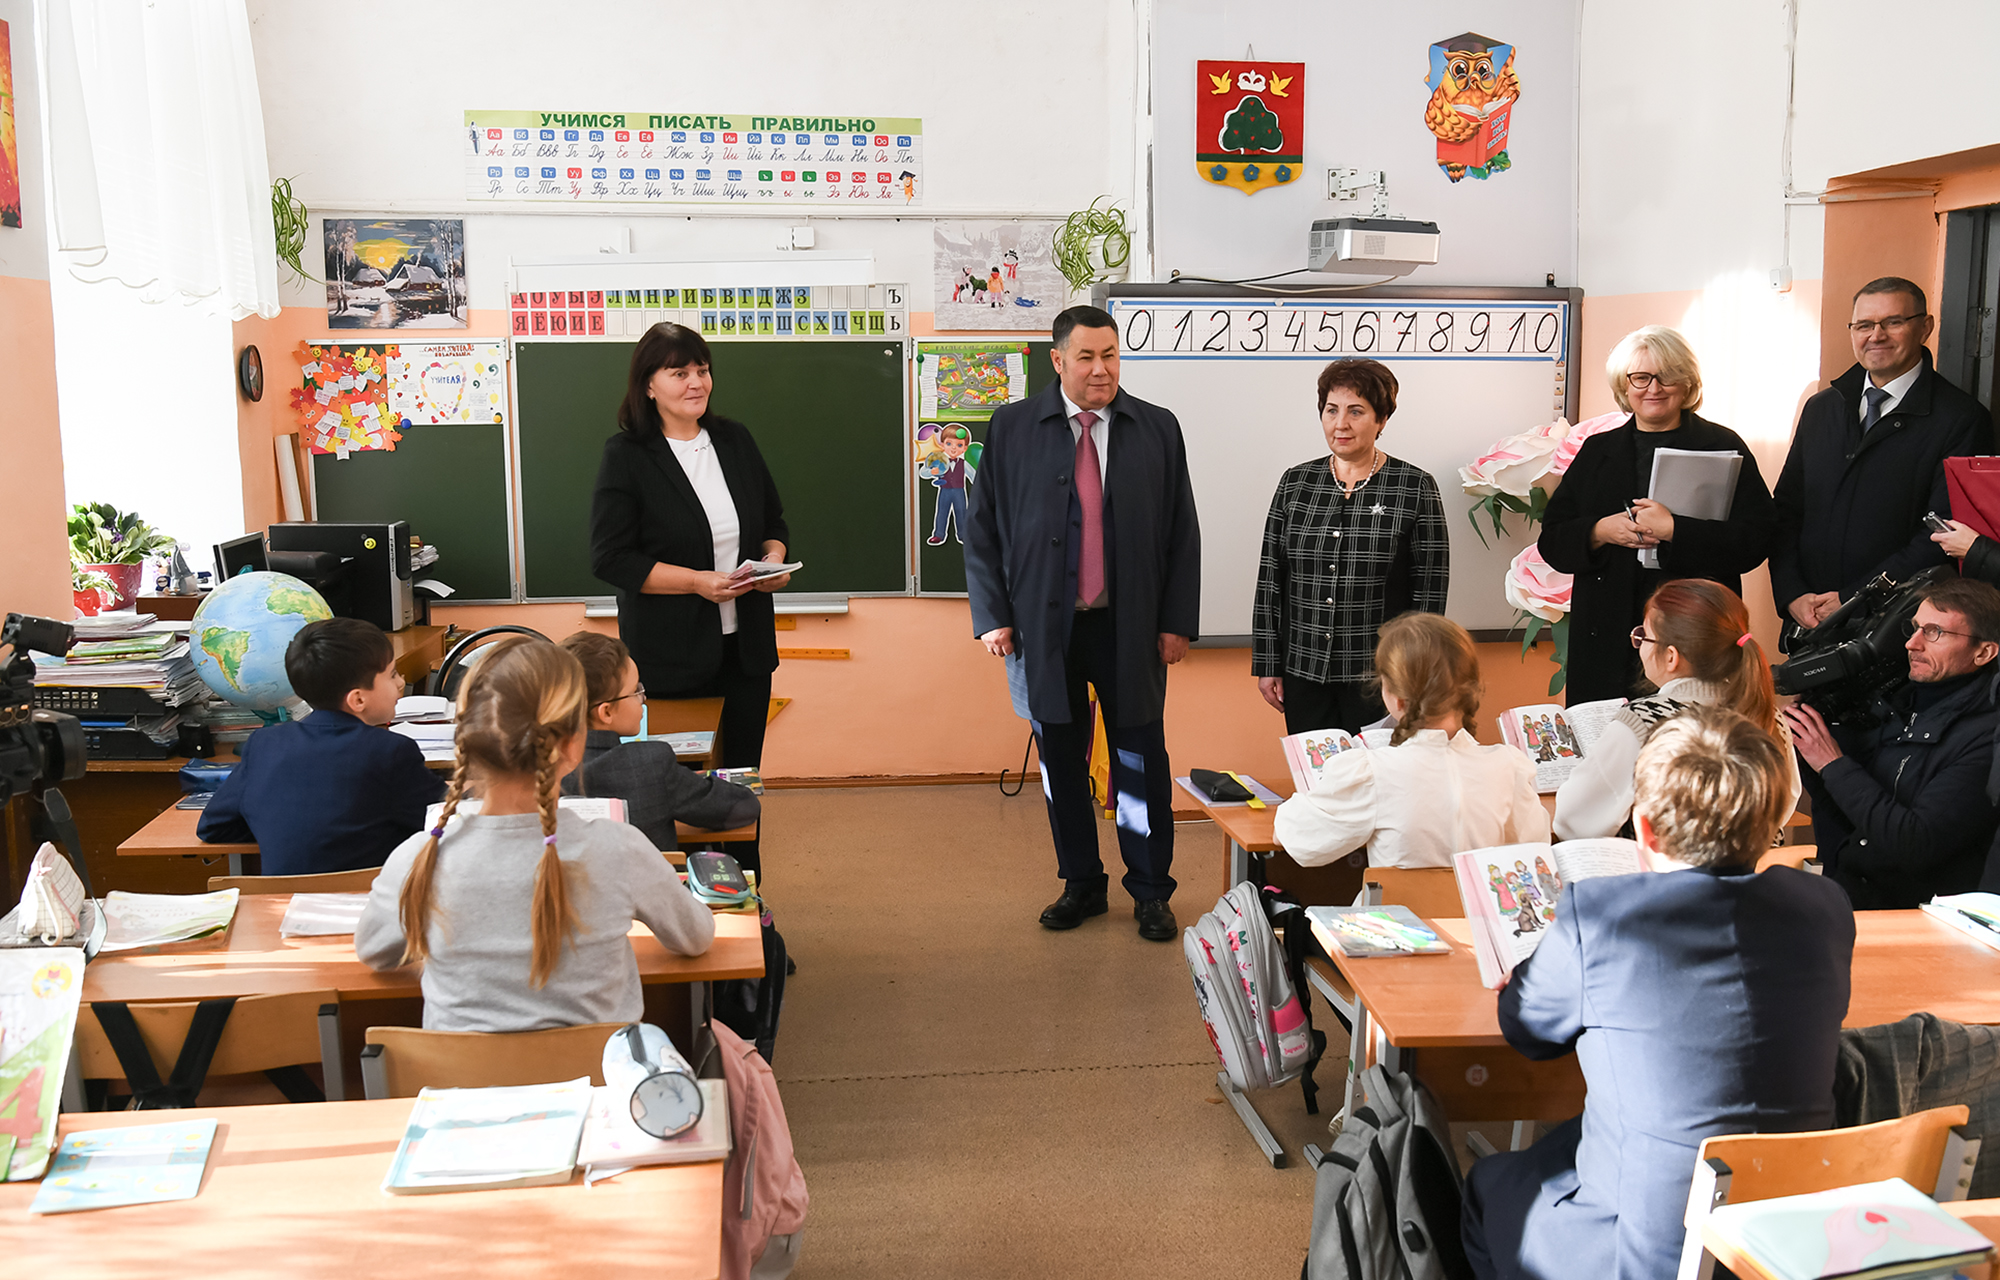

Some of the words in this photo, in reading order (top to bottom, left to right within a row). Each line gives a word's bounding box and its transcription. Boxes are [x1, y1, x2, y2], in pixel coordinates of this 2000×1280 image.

[540, 113, 625, 127] УЧИМСЯ
[649, 115, 731, 128] ПИСАТЬ
[752, 117, 876, 132] ПРАВИЛЬНО
[516, 130, 526, 138] Бб
[542, 131, 552, 139] Вв
[567, 131, 576, 139] Гг
[591, 131, 602, 140] Дд
[641, 132, 651, 141] Ёё
[672, 133, 685, 141] Жж
[749, 135, 759, 143] Йй
[826, 136, 838, 144] Мм
[854, 137, 865, 145] Нн
[876, 137, 887, 145] Оо
[490, 169, 500, 177] Рр
[544, 169, 553, 177] Тт
[569, 169, 580, 178] Уу
[592, 170, 606, 178] Фф
[621, 170, 632, 178] Хх
[647, 170, 658, 179] Цц
[696, 171, 710, 179] Шш
[728, 171, 742, 180] Щщ
[828, 173, 839, 181] Ээ
[852, 174, 866, 182] Юю
[879, 174, 890, 182] Яя
[514, 293, 526, 303] А
[532, 293, 543, 304] О
[551, 291, 563, 303] У
[569, 291, 584, 303] Ы
[590, 291, 600, 303] Э
[608, 290, 621, 303] Л
[627, 290, 641, 303] М
[646, 290, 659, 303] Н
[665, 289, 675, 303] Р
[703, 289, 713, 303] Б
[723, 289, 733, 303] В
[741, 289, 751, 303] Г
[759, 289, 771, 307] Д
[776, 289, 791, 303] Ж
[797, 289, 807, 304] З
[888, 289, 901, 303] Ъ
[515, 316, 526, 330] Я
[535, 313, 545, 330] Ё
[551, 316, 566, 330] Ю
[572, 316, 584, 330] И
[593, 316, 602, 330] Е
[703, 316, 715, 330] П
[721, 316, 735, 330] Ф
[742, 316, 754, 330] К
[760, 316, 771, 330] Т
[776, 316, 792, 330] Ш
[797, 316, 808, 330] С
[815, 316, 827, 330] Х
[834, 316, 846, 333] Ц
[853, 316, 865, 330] Ч
[869, 316, 885, 333] Щ
[890, 316, 900, 330] Ь
[1126, 310, 1151, 351] 0
[1175, 310, 1192, 351] 1
[1202, 310, 1230, 351] 2
[1240, 310, 1268, 351] 3
[1284, 310, 1304, 351] 4
[1313, 311, 1343, 352] 5
[1353, 311, 1380, 352] 6
[1393, 311, 1417, 352] 7
[1429, 311, 1453, 352] 8
[1464, 311, 1490, 352] 9
